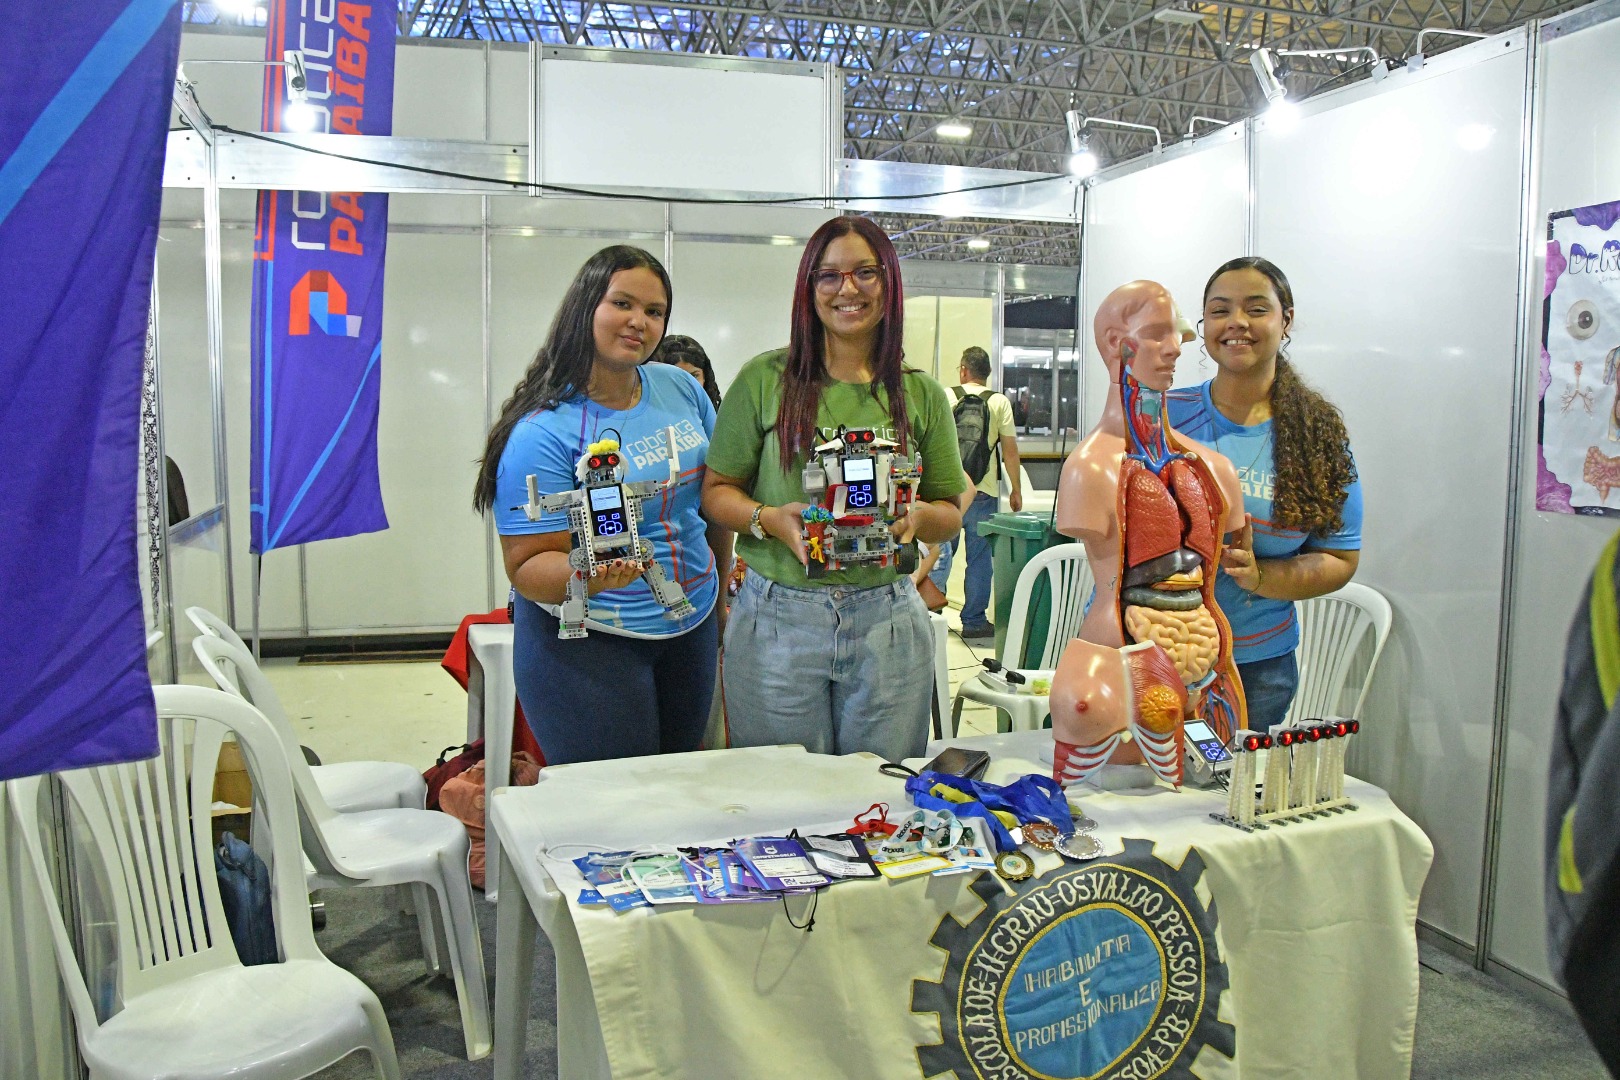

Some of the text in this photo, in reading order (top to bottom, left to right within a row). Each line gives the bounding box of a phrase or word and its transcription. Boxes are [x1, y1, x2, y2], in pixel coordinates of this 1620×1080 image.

[329, 1, 372, 256] PAAÍBA
[1015, 979, 1161, 1053] PROFISSIONALIZA
[1078, 977, 1093, 1007] E
